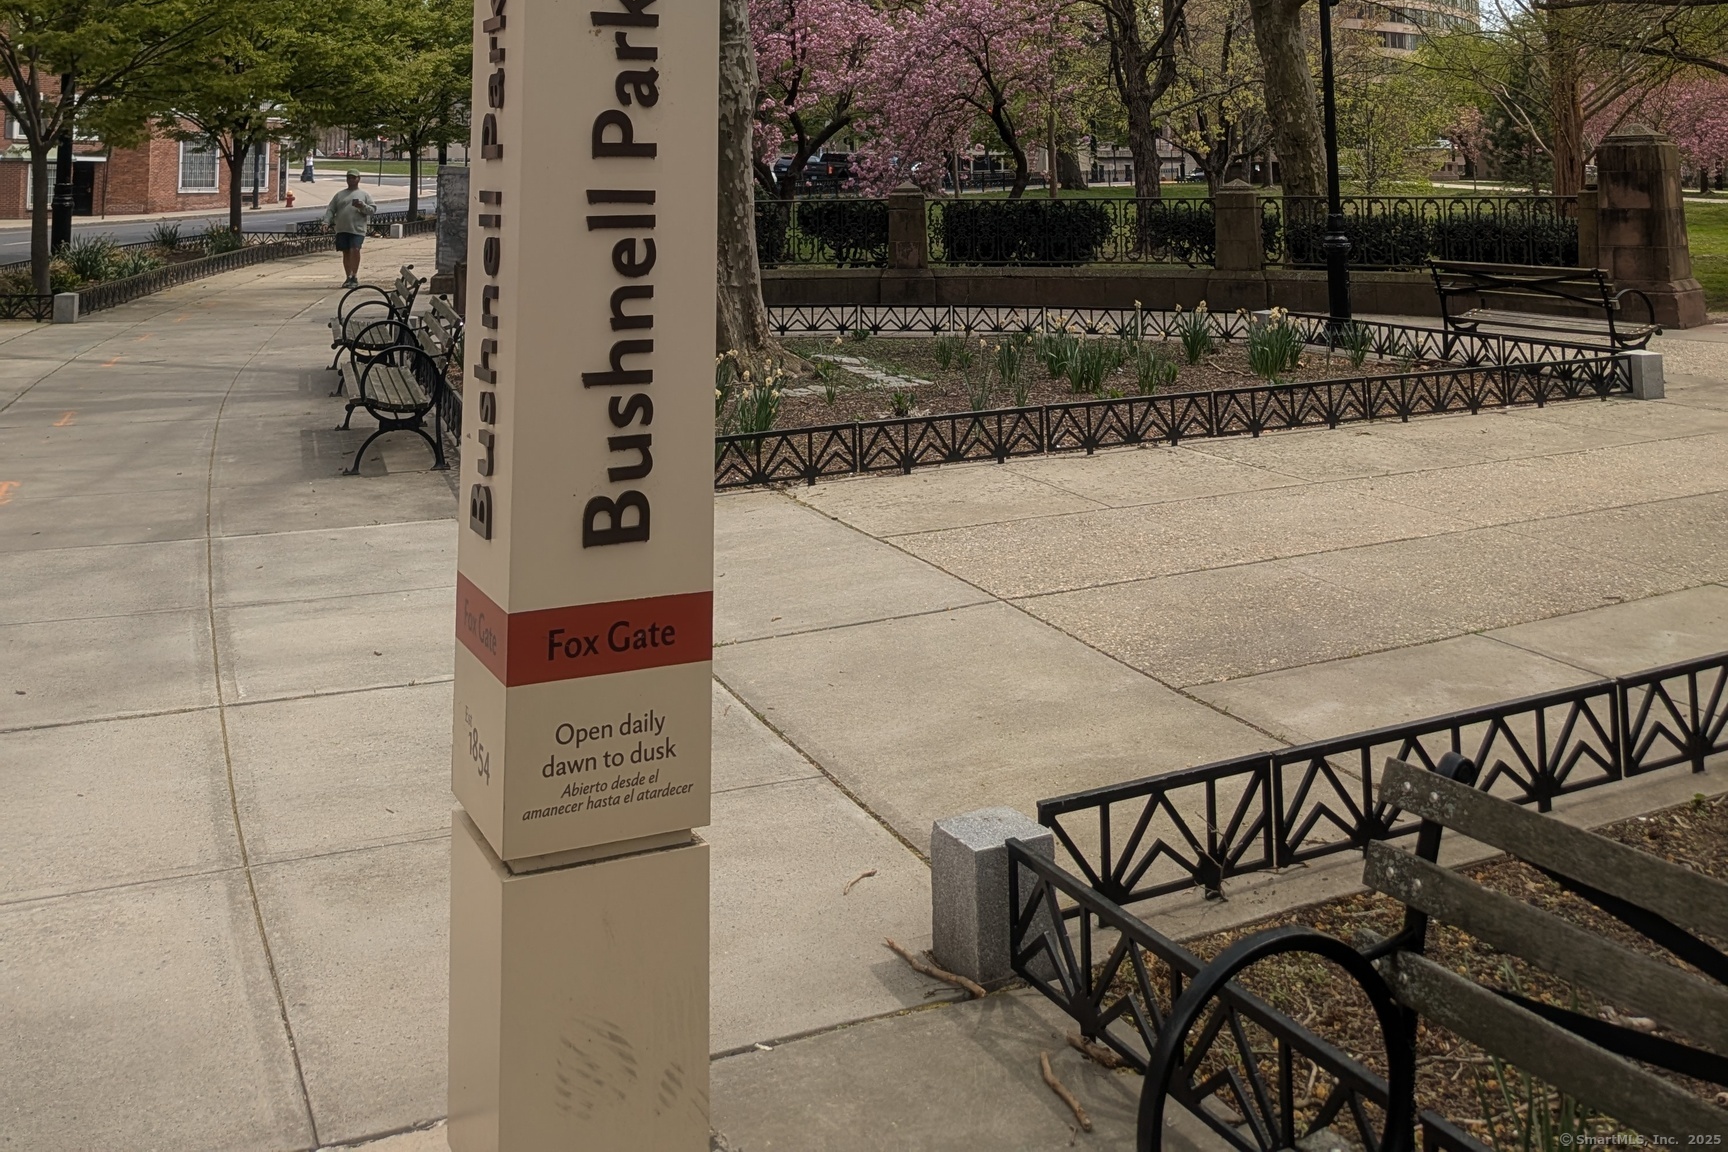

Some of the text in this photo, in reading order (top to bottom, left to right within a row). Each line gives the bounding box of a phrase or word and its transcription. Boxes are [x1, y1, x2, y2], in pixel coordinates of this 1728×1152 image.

[470, 189, 503, 541] Bushnell
[582, 188, 657, 549] Bushnell
[463, 599, 498, 656] Fox Gate
[547, 620, 676, 661] Fox Gate
[555, 709, 666, 748] Open daily
[468, 728, 490, 786] 1854
[542, 737, 677, 778] dawn to dusk
[522, 782, 694, 821] amanecer hasta el atardecer
[560, 769, 660, 799] Abierto desde el
